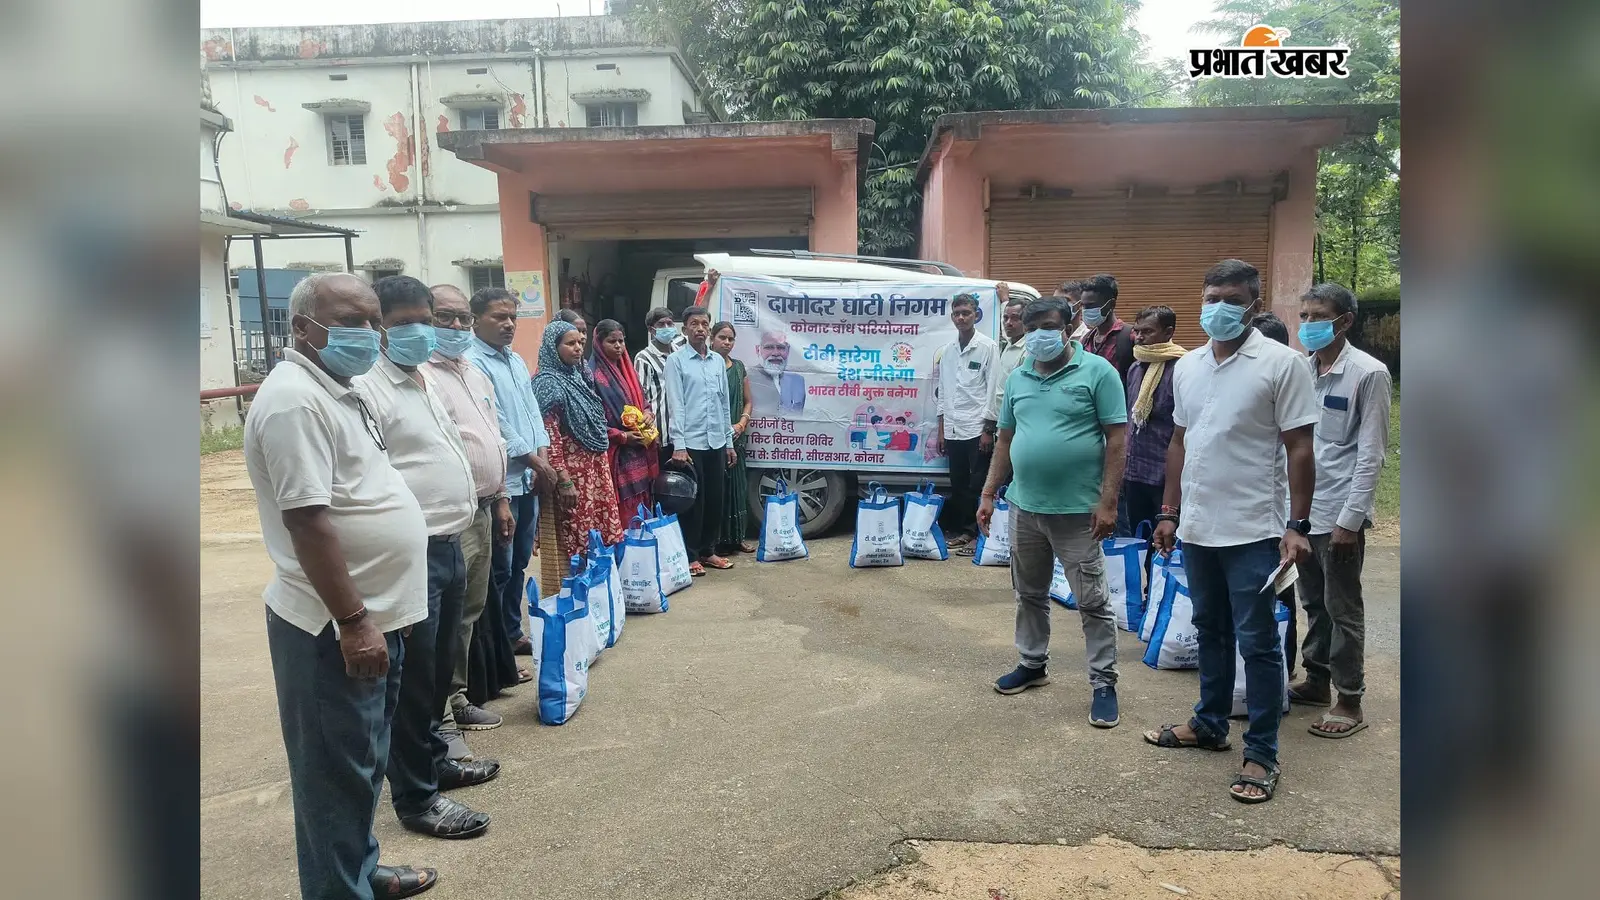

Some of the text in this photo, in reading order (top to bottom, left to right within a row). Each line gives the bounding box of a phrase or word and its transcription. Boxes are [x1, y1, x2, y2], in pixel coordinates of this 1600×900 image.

[766, 294, 838, 316] दामोदर
[841, 293, 884, 316] घाटी
[889, 293, 948, 316] निगम
[790, 319, 830, 334] कोनार
[857, 320, 920, 335] परियोजना
[803, 343, 836, 361] टीबी
[838, 345, 881, 363] हारेगा
[837, 364, 915, 382] देश जीतेगा
[808, 383, 919, 401] भारत टीबी मुक्त बनेगा
[749, 416, 795, 433] मरीजों हेतु
[751, 431, 771, 444] किट
[773, 431, 804, 446] वितरण
[806, 433, 834, 446] शिविर
[771, 447, 804, 461] डीवीसी,
[806, 450, 852, 463] सीएसआर,
[854, 451, 885, 463] कोनार
